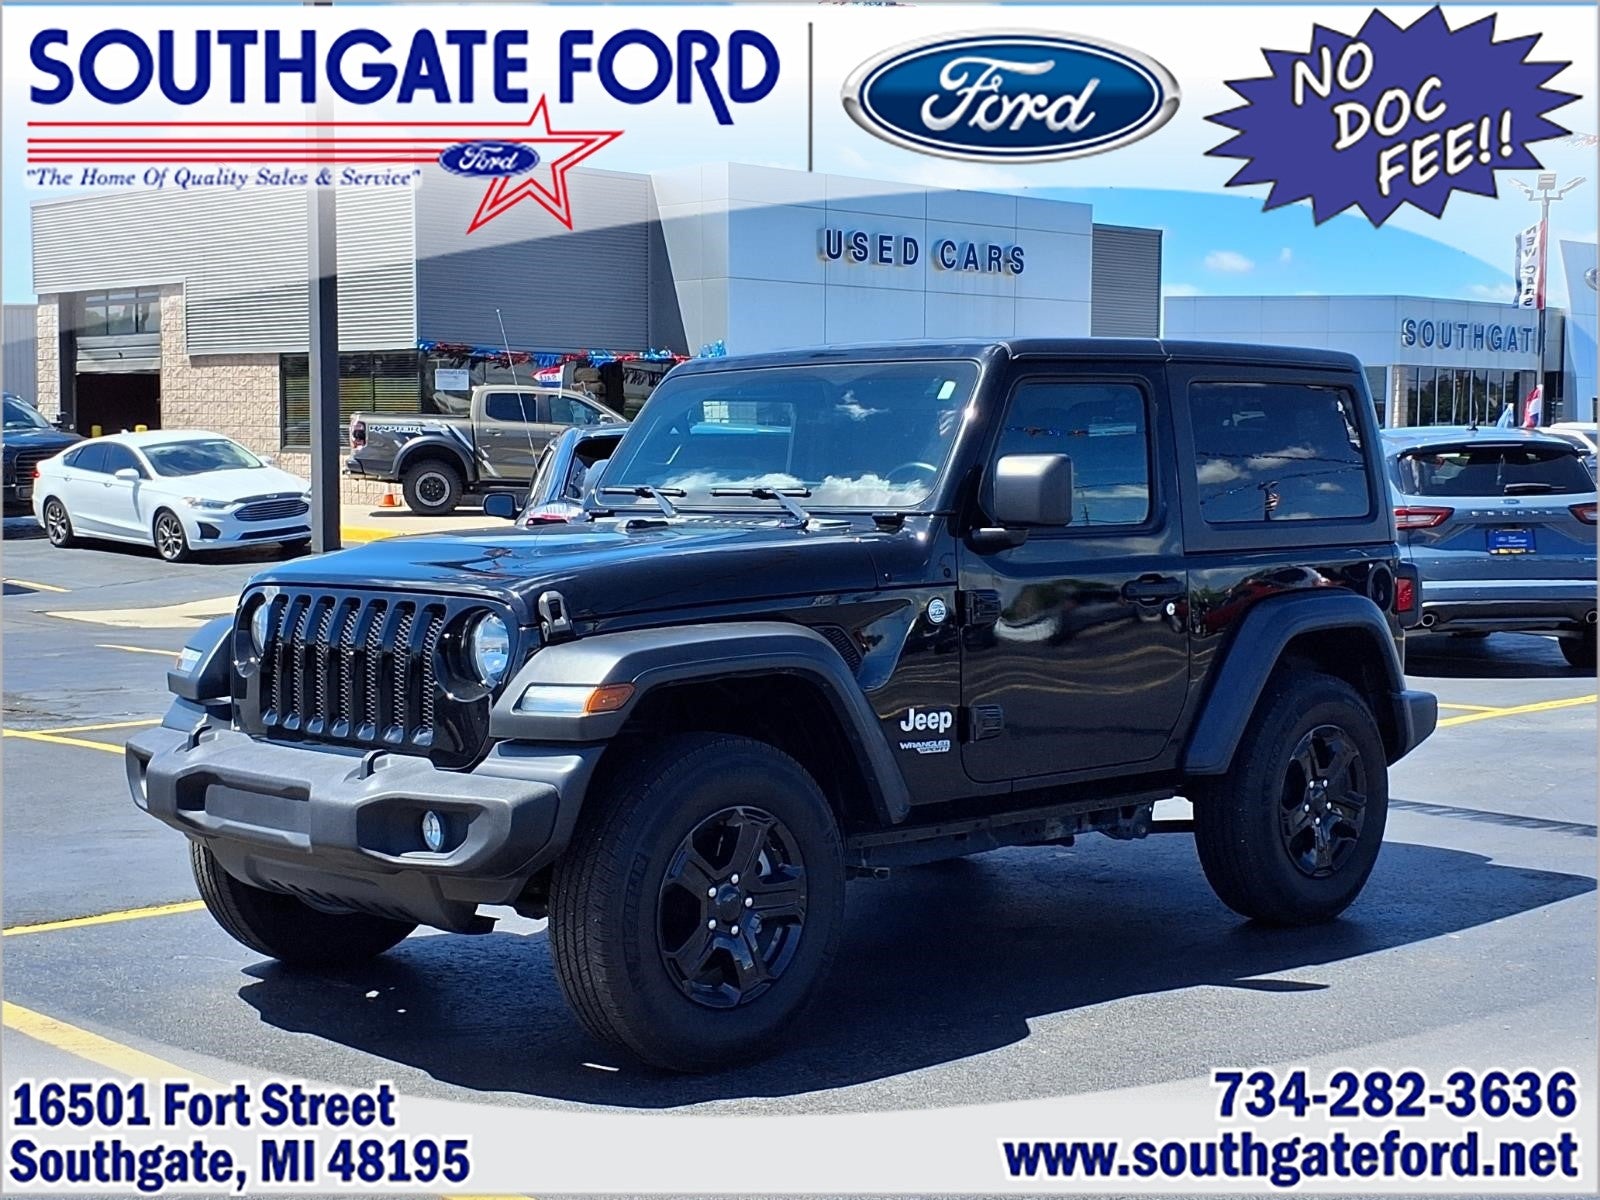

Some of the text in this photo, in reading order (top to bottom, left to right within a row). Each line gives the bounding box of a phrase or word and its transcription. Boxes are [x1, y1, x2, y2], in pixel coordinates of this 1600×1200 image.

[822, 229, 1025, 276] USED CARS
[1402, 318, 1543, 352] SOUTHGAT
[900, 708, 953, 733] Jeep
[899, 740, 950, 750] WRANGLER
